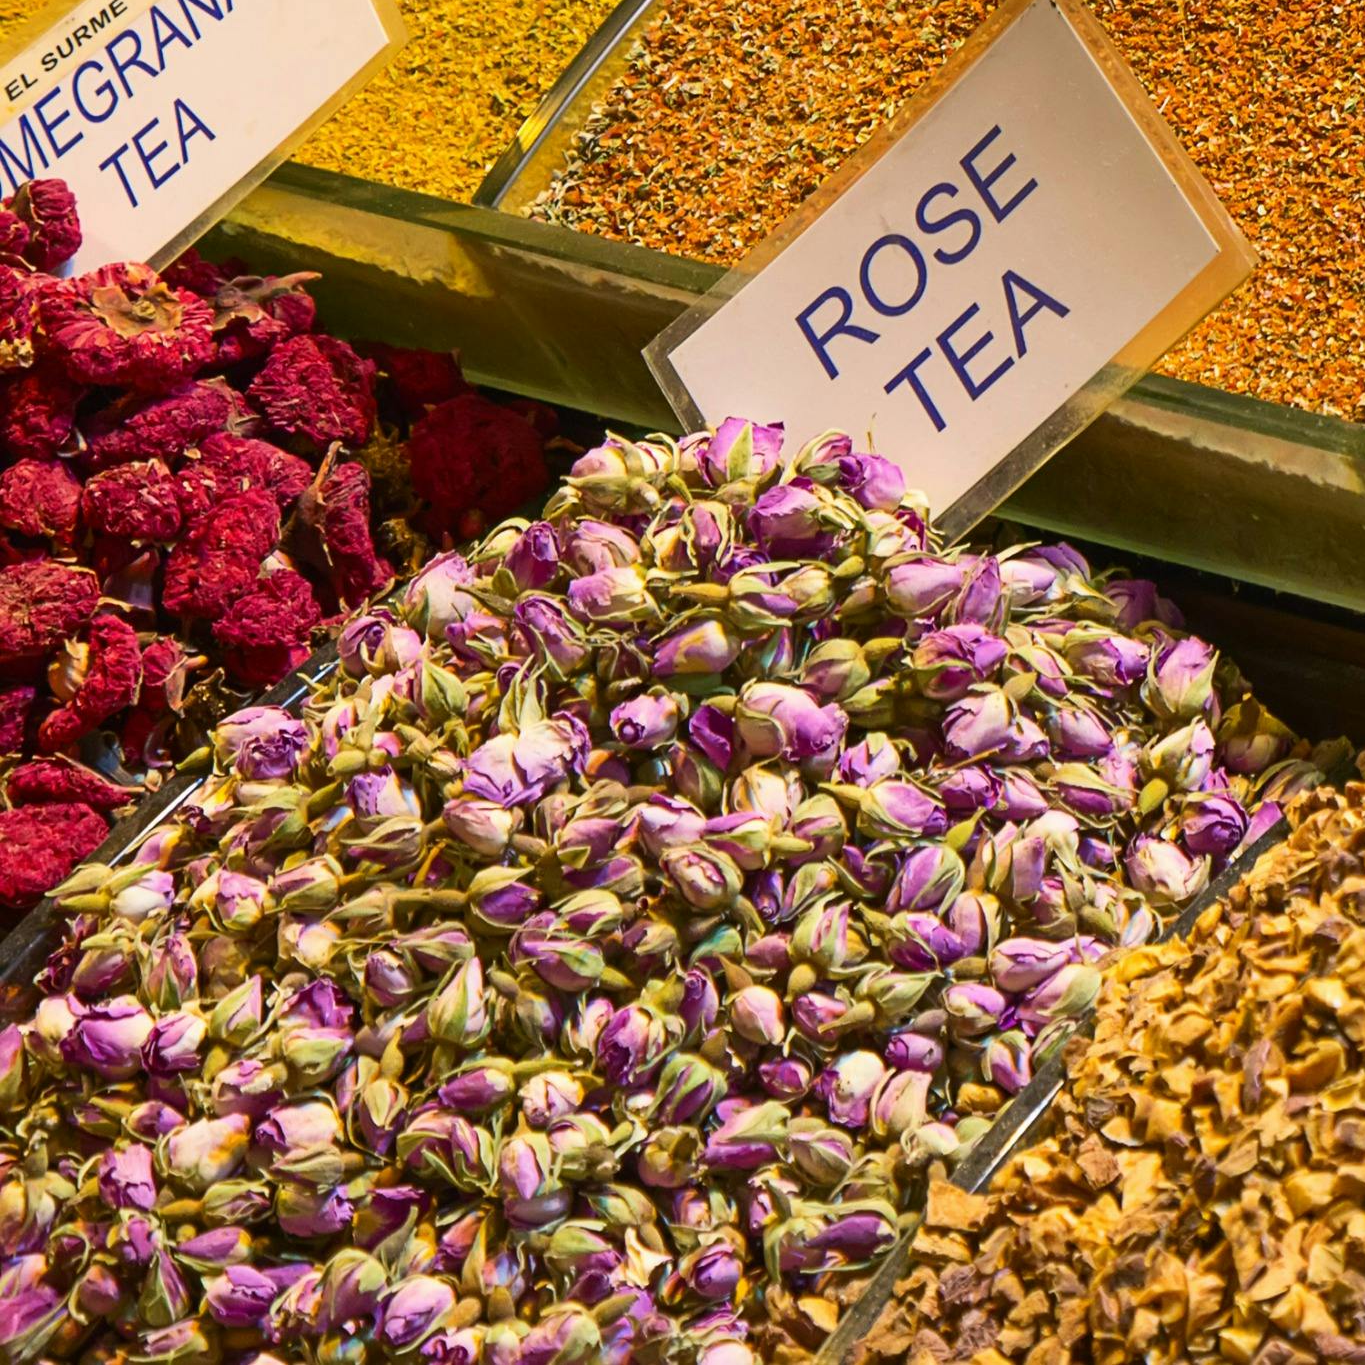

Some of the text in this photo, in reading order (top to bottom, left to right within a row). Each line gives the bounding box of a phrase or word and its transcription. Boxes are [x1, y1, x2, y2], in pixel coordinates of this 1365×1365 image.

[4, 67, 38, 102] EL
[98, 98, 216, 209] TEA
[794, 124, 1040, 380] ROSE
[883, 269, 1071, 434] TEA
